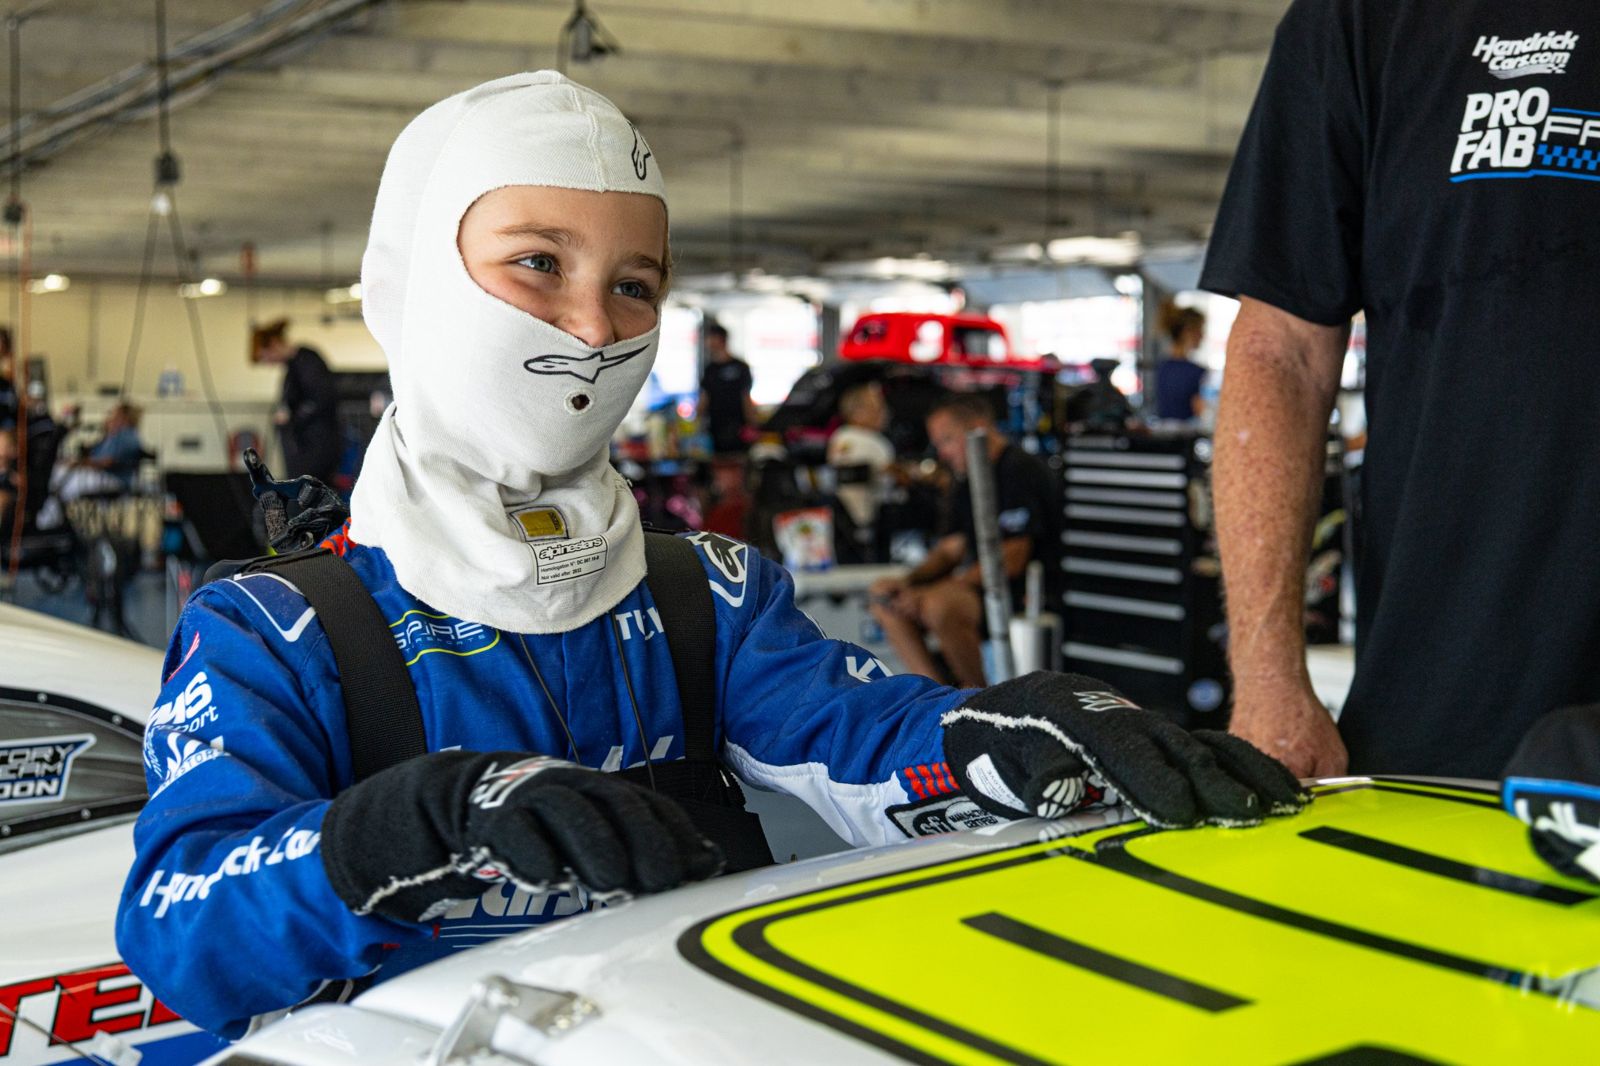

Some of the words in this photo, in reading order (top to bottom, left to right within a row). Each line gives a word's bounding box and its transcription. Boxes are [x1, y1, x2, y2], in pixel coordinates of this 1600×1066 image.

[1472, 31, 1580, 63] Hendrick
[1488, 51, 1571, 71] Cars.com
[1460, 86, 1550, 133] PRO
[1450, 126, 1538, 174] FAB
[538, 537, 603, 560] alpinestars
